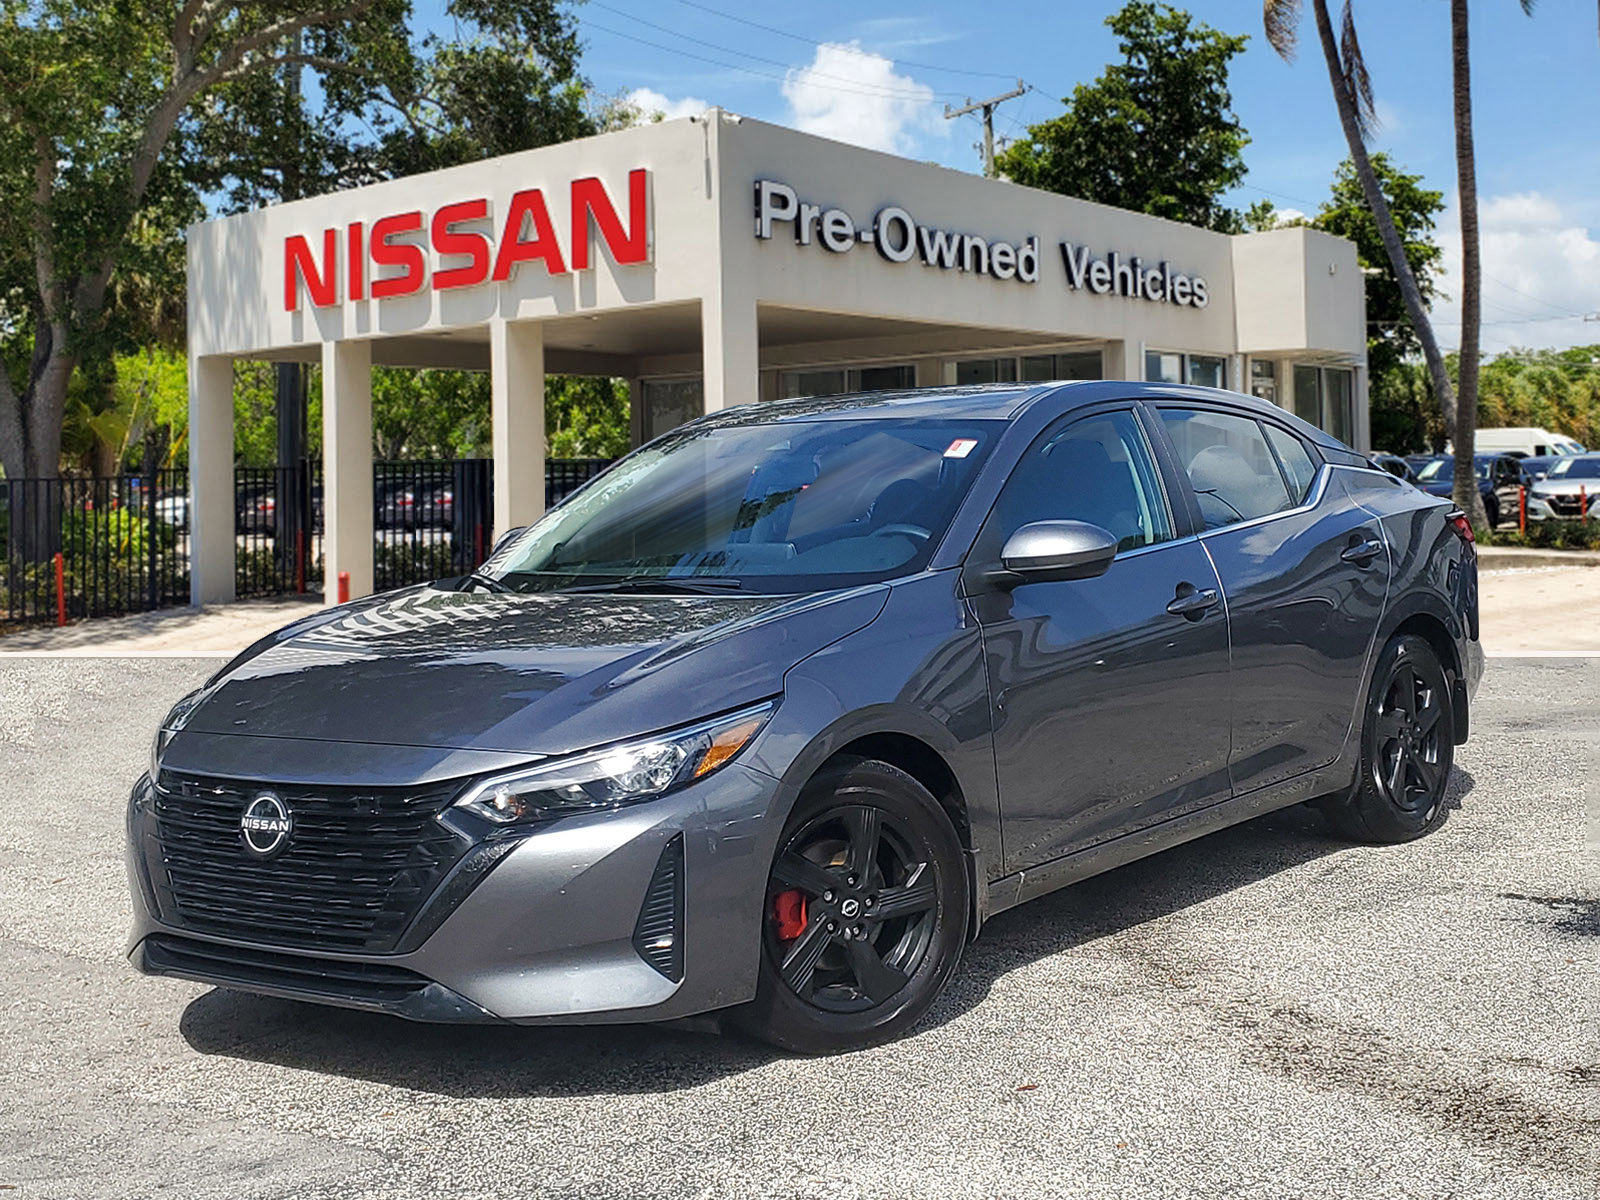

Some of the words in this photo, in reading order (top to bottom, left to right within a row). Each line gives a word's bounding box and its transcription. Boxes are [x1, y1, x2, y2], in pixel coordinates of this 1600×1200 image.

[285, 168, 648, 311] NISSAN
[754, 179, 1040, 283] Pre-Owned
[1060, 241, 1208, 308] Vehicles
[241, 817, 290, 832] NISSAN
